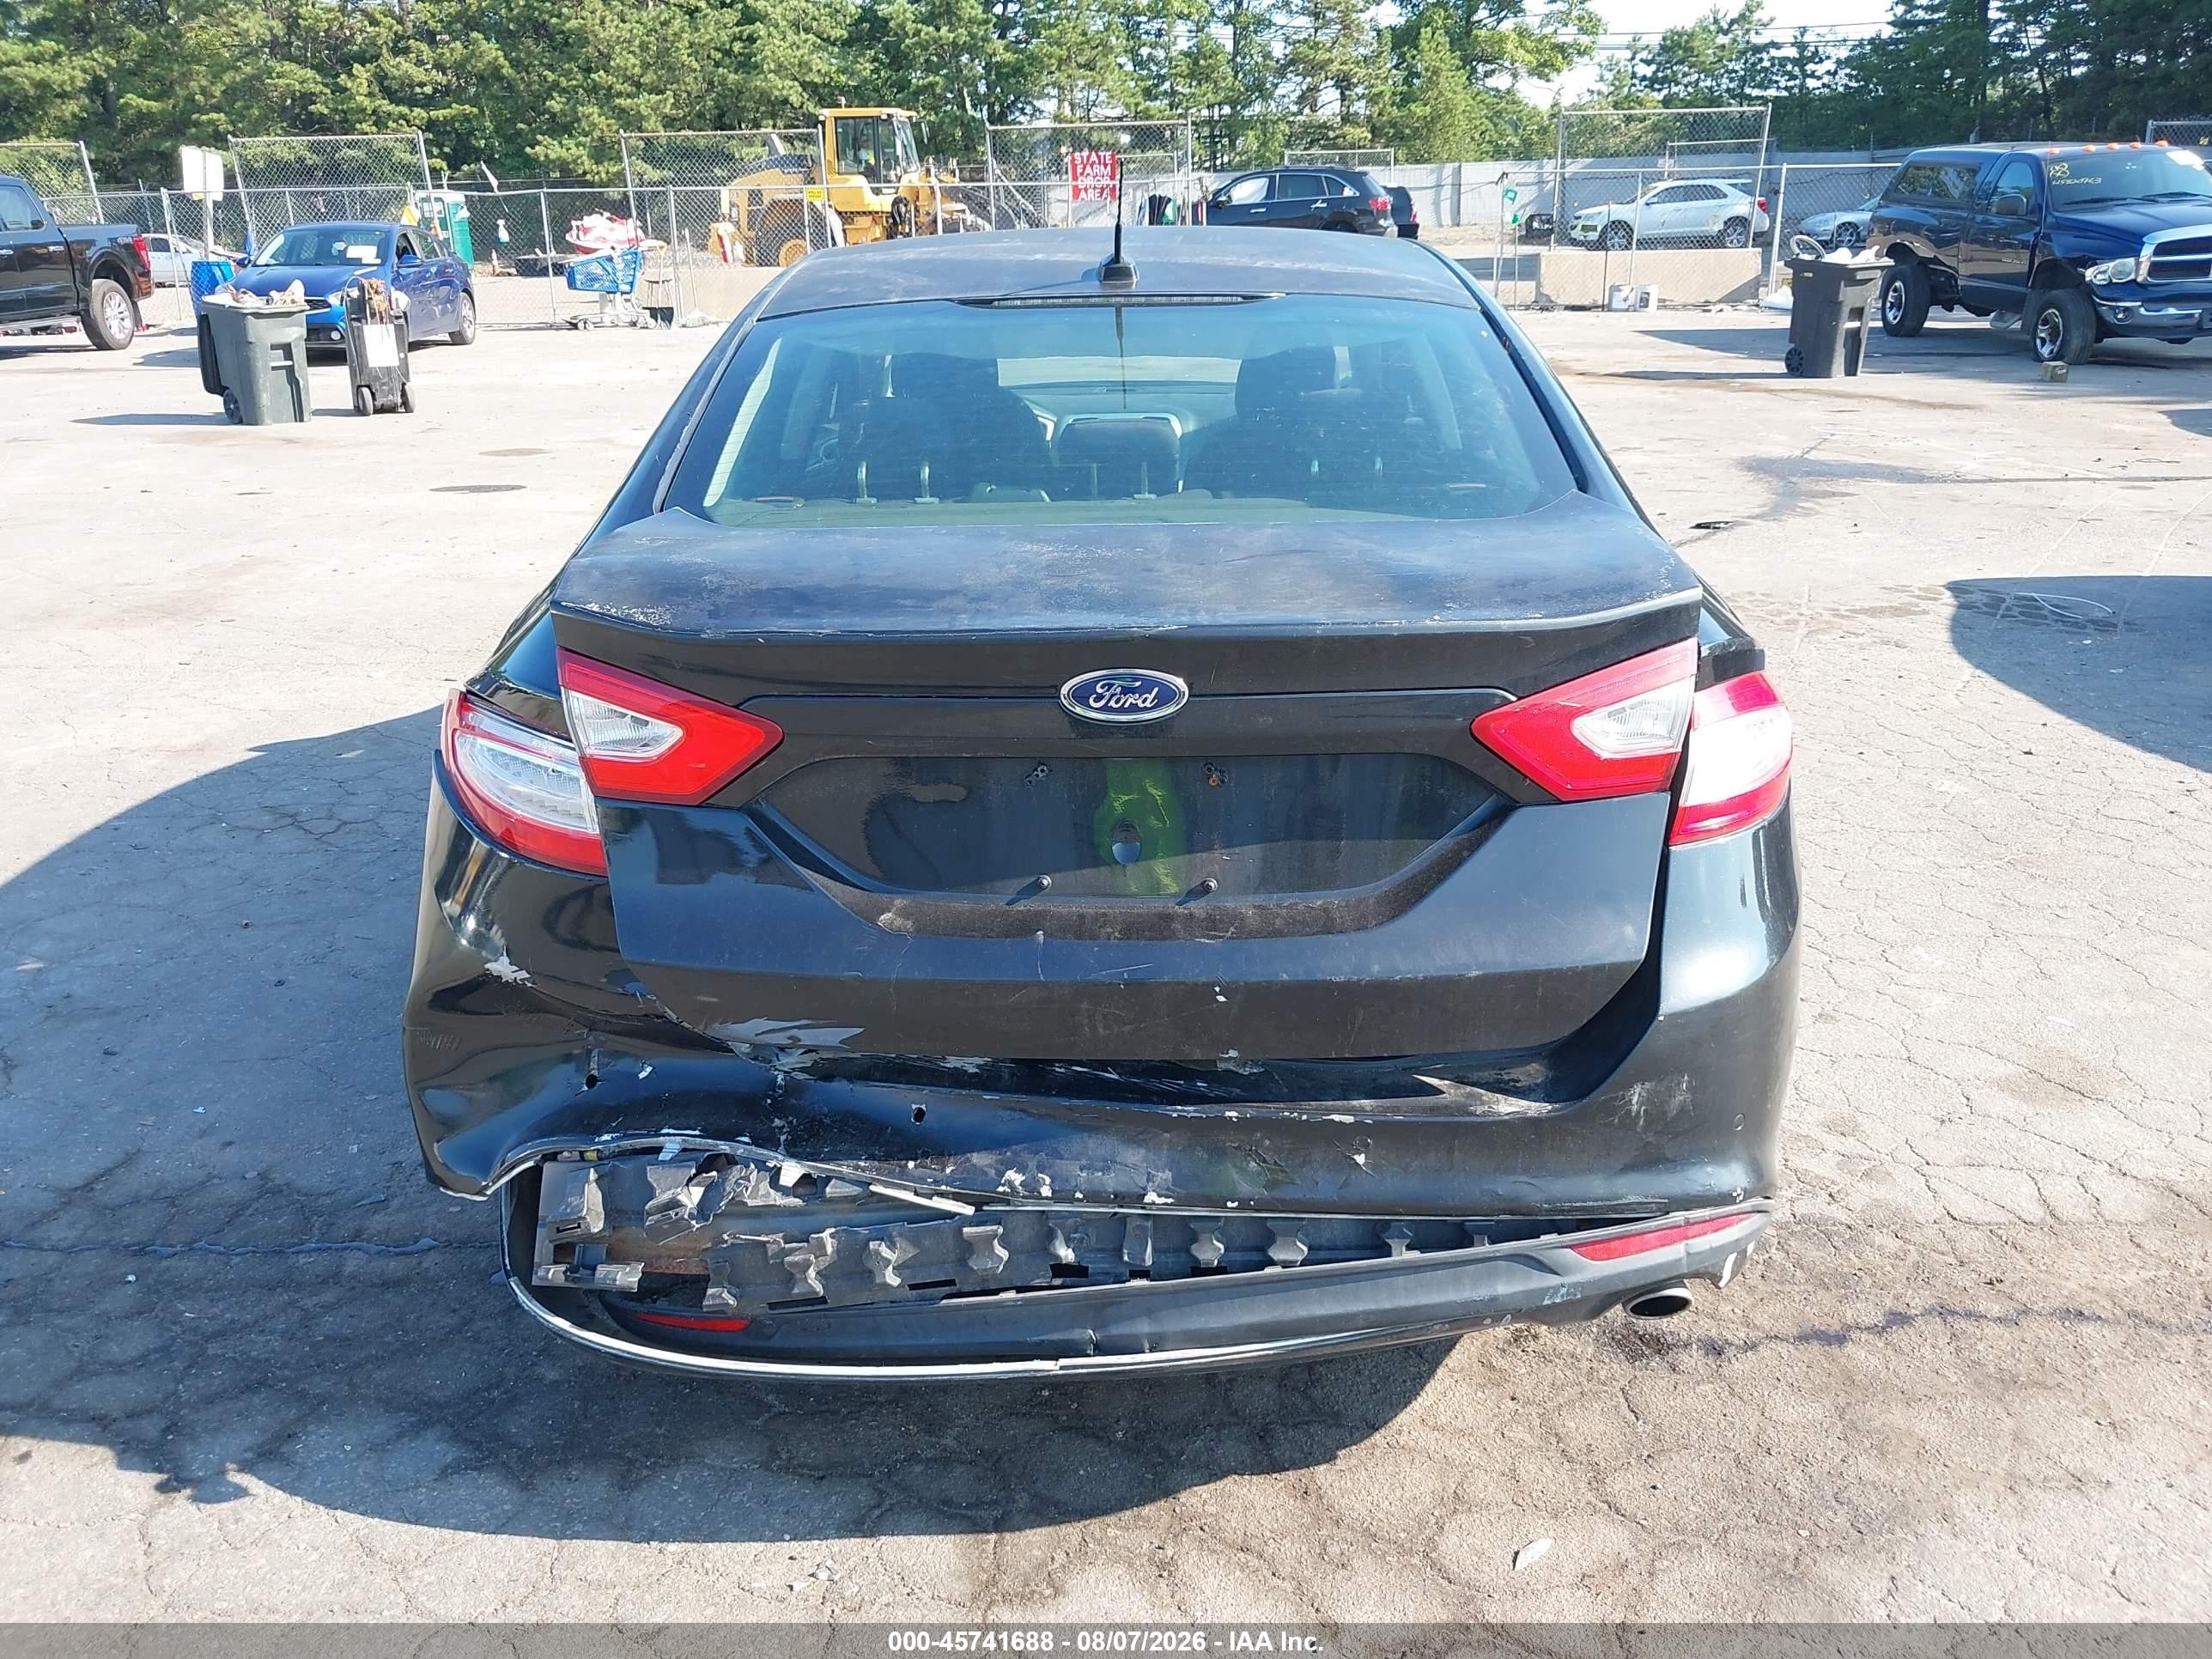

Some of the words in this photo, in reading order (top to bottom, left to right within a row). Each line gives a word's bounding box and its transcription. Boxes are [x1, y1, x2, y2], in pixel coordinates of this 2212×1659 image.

[1073, 151, 1113, 164] STATE
[1076, 164, 1112, 177] FARM
[1077, 176, 1114, 189] DROP
[1078, 188, 1112, 201] AREA
[1089, 680, 1159, 708] Ford
